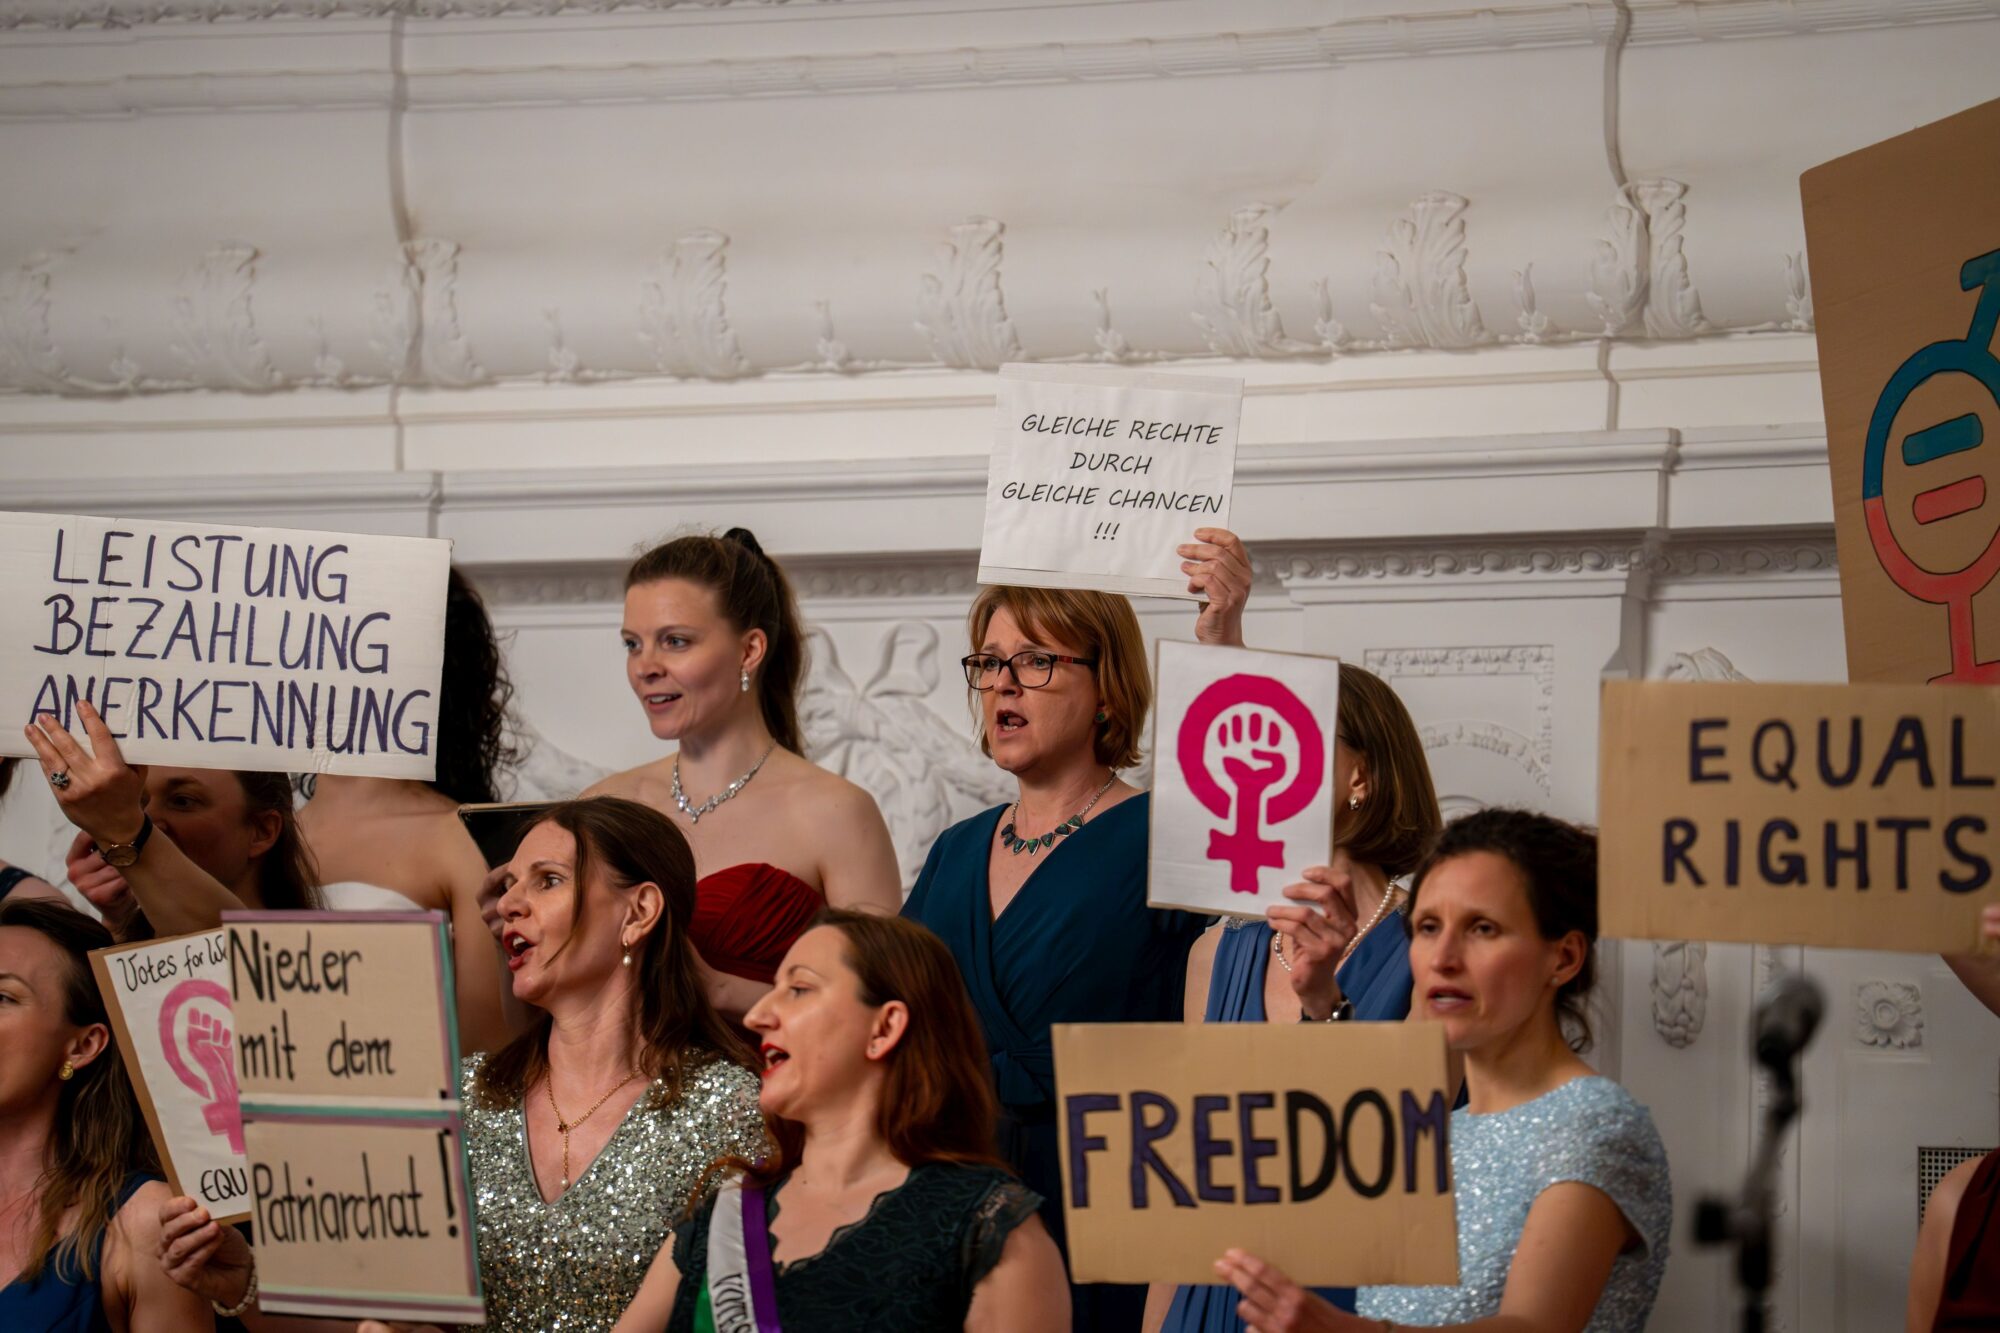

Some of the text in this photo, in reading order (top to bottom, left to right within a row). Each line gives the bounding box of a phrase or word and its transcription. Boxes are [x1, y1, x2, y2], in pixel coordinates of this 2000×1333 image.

[1021, 413, 1224, 445] GLEICHE RECHTE
[1069, 451, 1153, 475] DURCH
[1001, 481, 1224, 514] GLEICHE CHANCEN
[1093, 521, 1121, 541] !!!
[52, 528, 348, 604] LEISTUNG
[33, 593, 391, 675] BEZAHLUNG
[29, 674, 431, 756] ANERKENNUNG
[1688, 714, 1997, 791] EQUAL
[1661, 814, 1993, 895] RIGHTS
[116, 952, 178, 993] Votes
[183, 944, 204, 978] for
[230, 928, 362, 1003] Nieder
[239, 1009, 396, 1081] mit dem
[1066, 1088, 1451, 1210] FREEDOM
